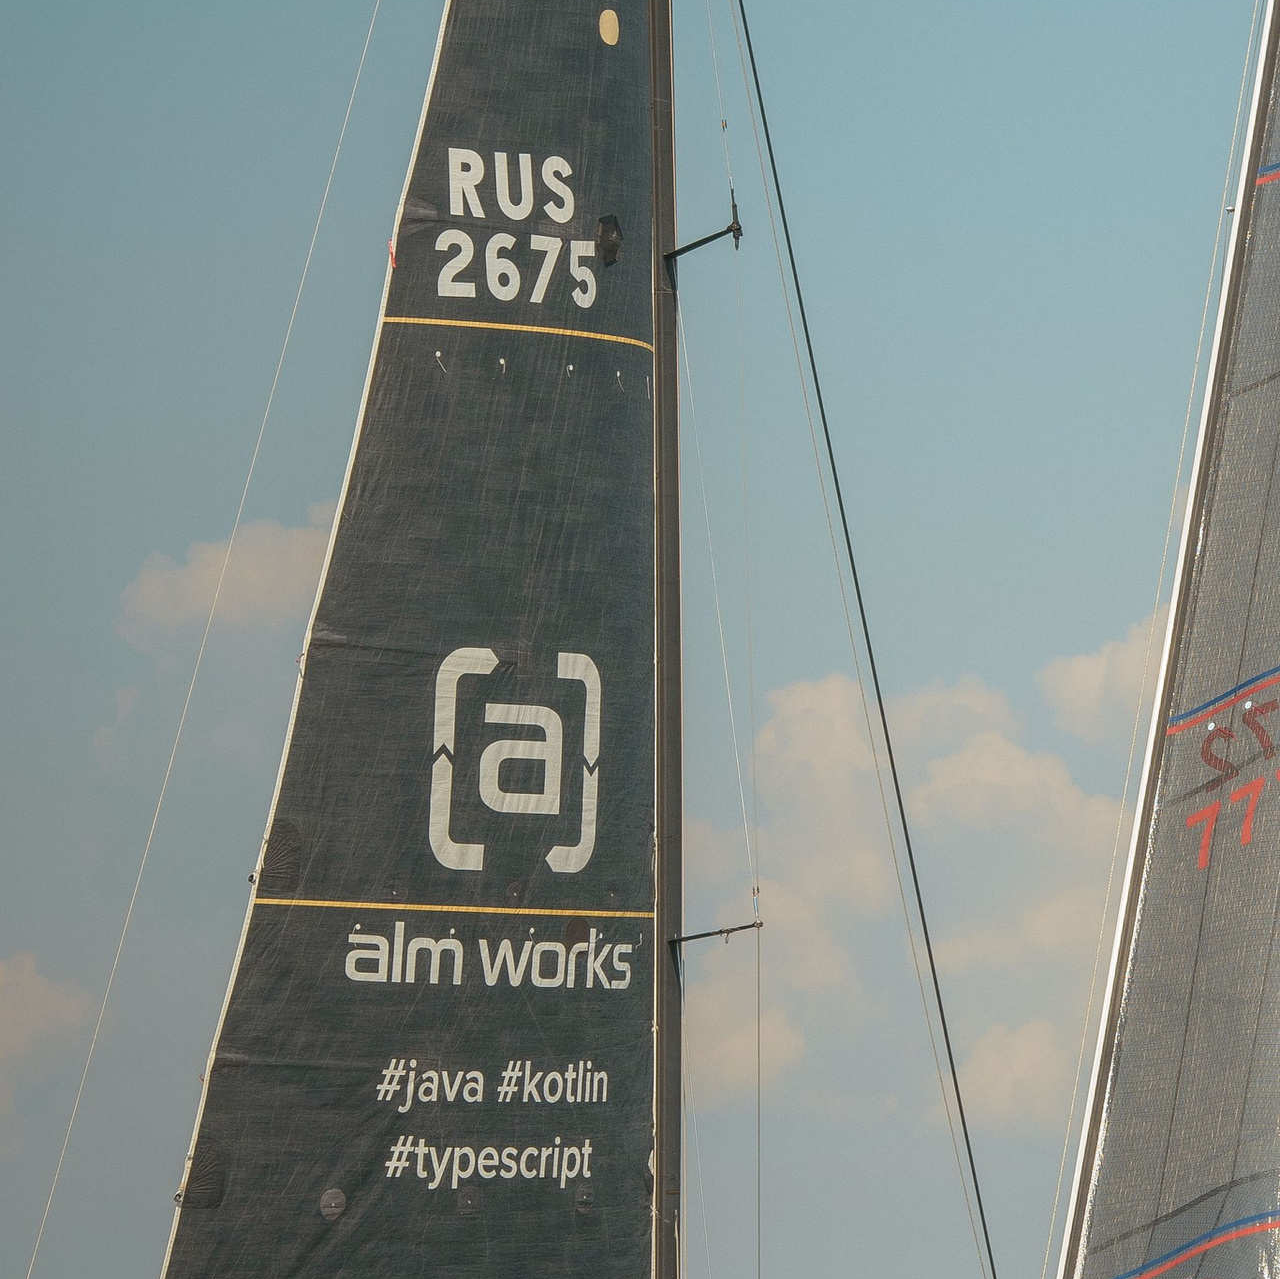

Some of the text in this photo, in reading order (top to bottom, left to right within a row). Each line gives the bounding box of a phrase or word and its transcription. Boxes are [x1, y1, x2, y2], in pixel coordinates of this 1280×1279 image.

[447, 147, 576, 224] RUS
[434, 229, 597, 309] 2675
[344, 921, 633, 990] alm works
[376, 1058, 609, 1114] #java #kotlin
[384, 1135, 593, 1190] #typescript
